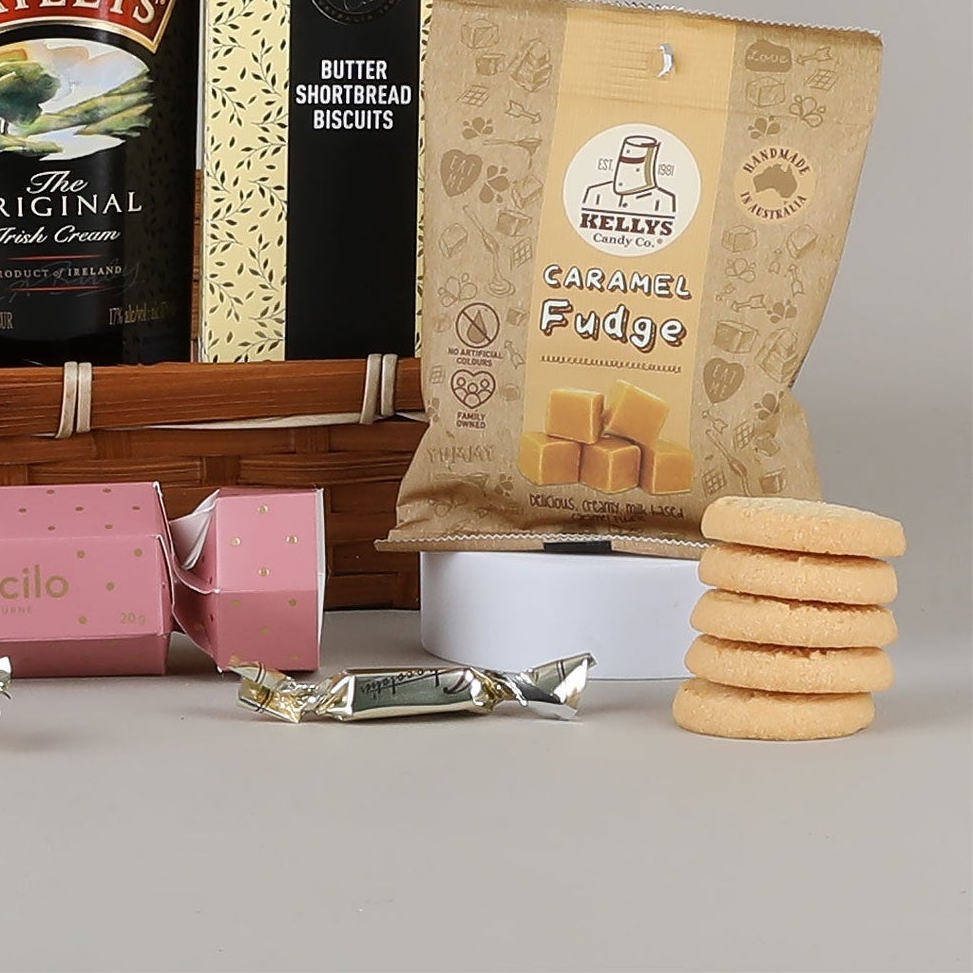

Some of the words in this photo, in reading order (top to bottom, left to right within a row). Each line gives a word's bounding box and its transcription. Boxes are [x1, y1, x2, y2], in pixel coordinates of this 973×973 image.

[321, 59, 388, 80] BUTTER
[295, 84, 412, 105] SHORTBREAD
[313, 109, 394, 130] BISCUITS
[597, 158, 614, 171] EST.
[743, 147, 810, 175] HANDMADE
[26, 170, 90, 195] The
[740, 191, 752, 206] IN
[748, 194, 807, 220] AUSTRALIA
[54, 224, 121, 244] Cream
[579, 213, 674, 236] KELLYS
[593, 232, 632, 248] Candy
[635, 237, 655, 248] Co.
[52, 268, 65, 278] of
[68, 265, 123, 277] IRELAND
[543, 264, 692, 299] CARAMEL
[538, 298, 687, 352] Fudge
[448, 348, 459, 356] NO
[460, 349, 504, 360] ARTIFICIAL
[456, 357, 493, 367] COLOURS
[456, 420, 487, 429] OWNED
[457, 412, 487, 421] FAMILY
